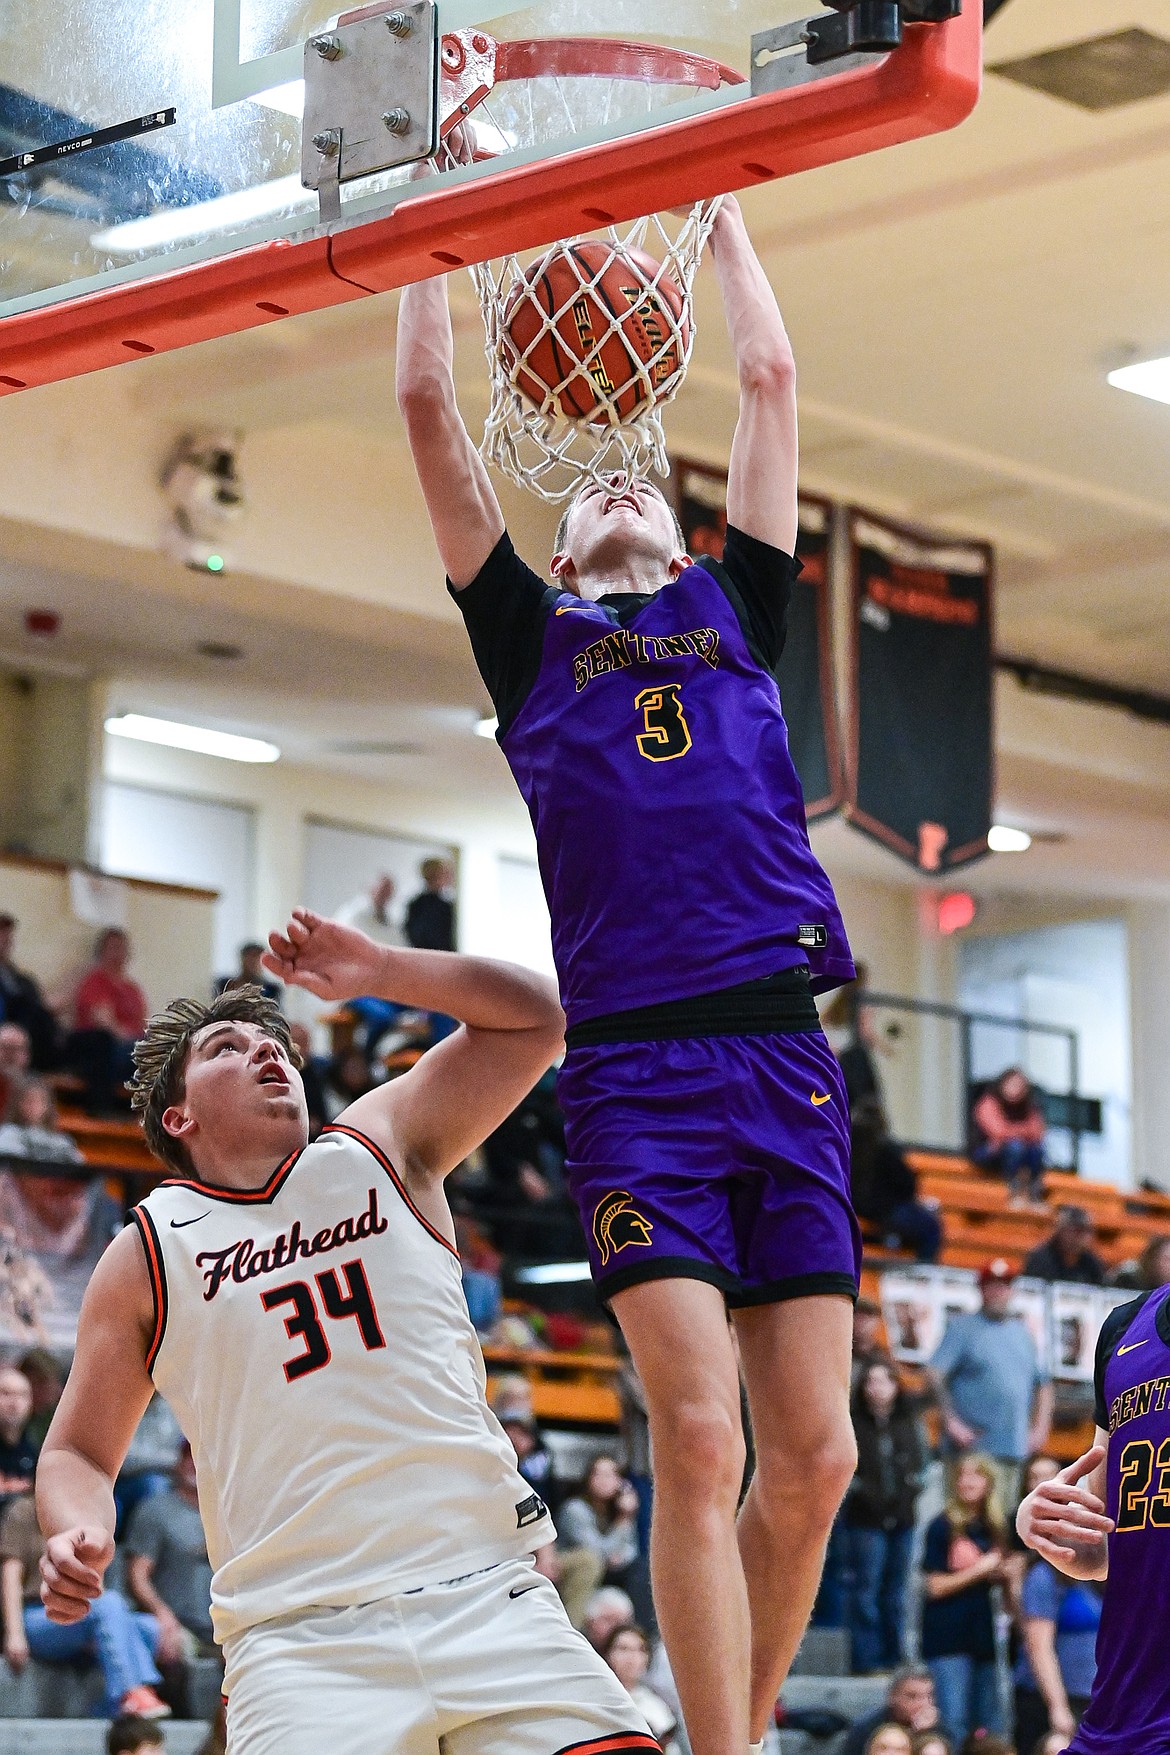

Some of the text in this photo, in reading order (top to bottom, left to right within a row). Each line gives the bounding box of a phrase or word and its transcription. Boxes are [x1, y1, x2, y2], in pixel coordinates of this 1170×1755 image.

[619, 286, 677, 383] Bade
[572, 627, 720, 693] SENTINEL
[634, 683, 693, 763] 3
[816, 931, 823, 942] L
[195, 1187, 388, 1301] Flathead
[259, 1257, 387, 1384] 34
[1108, 1375, 1170, 1438] SENT
[1115, 1437, 1170, 1533] 23
